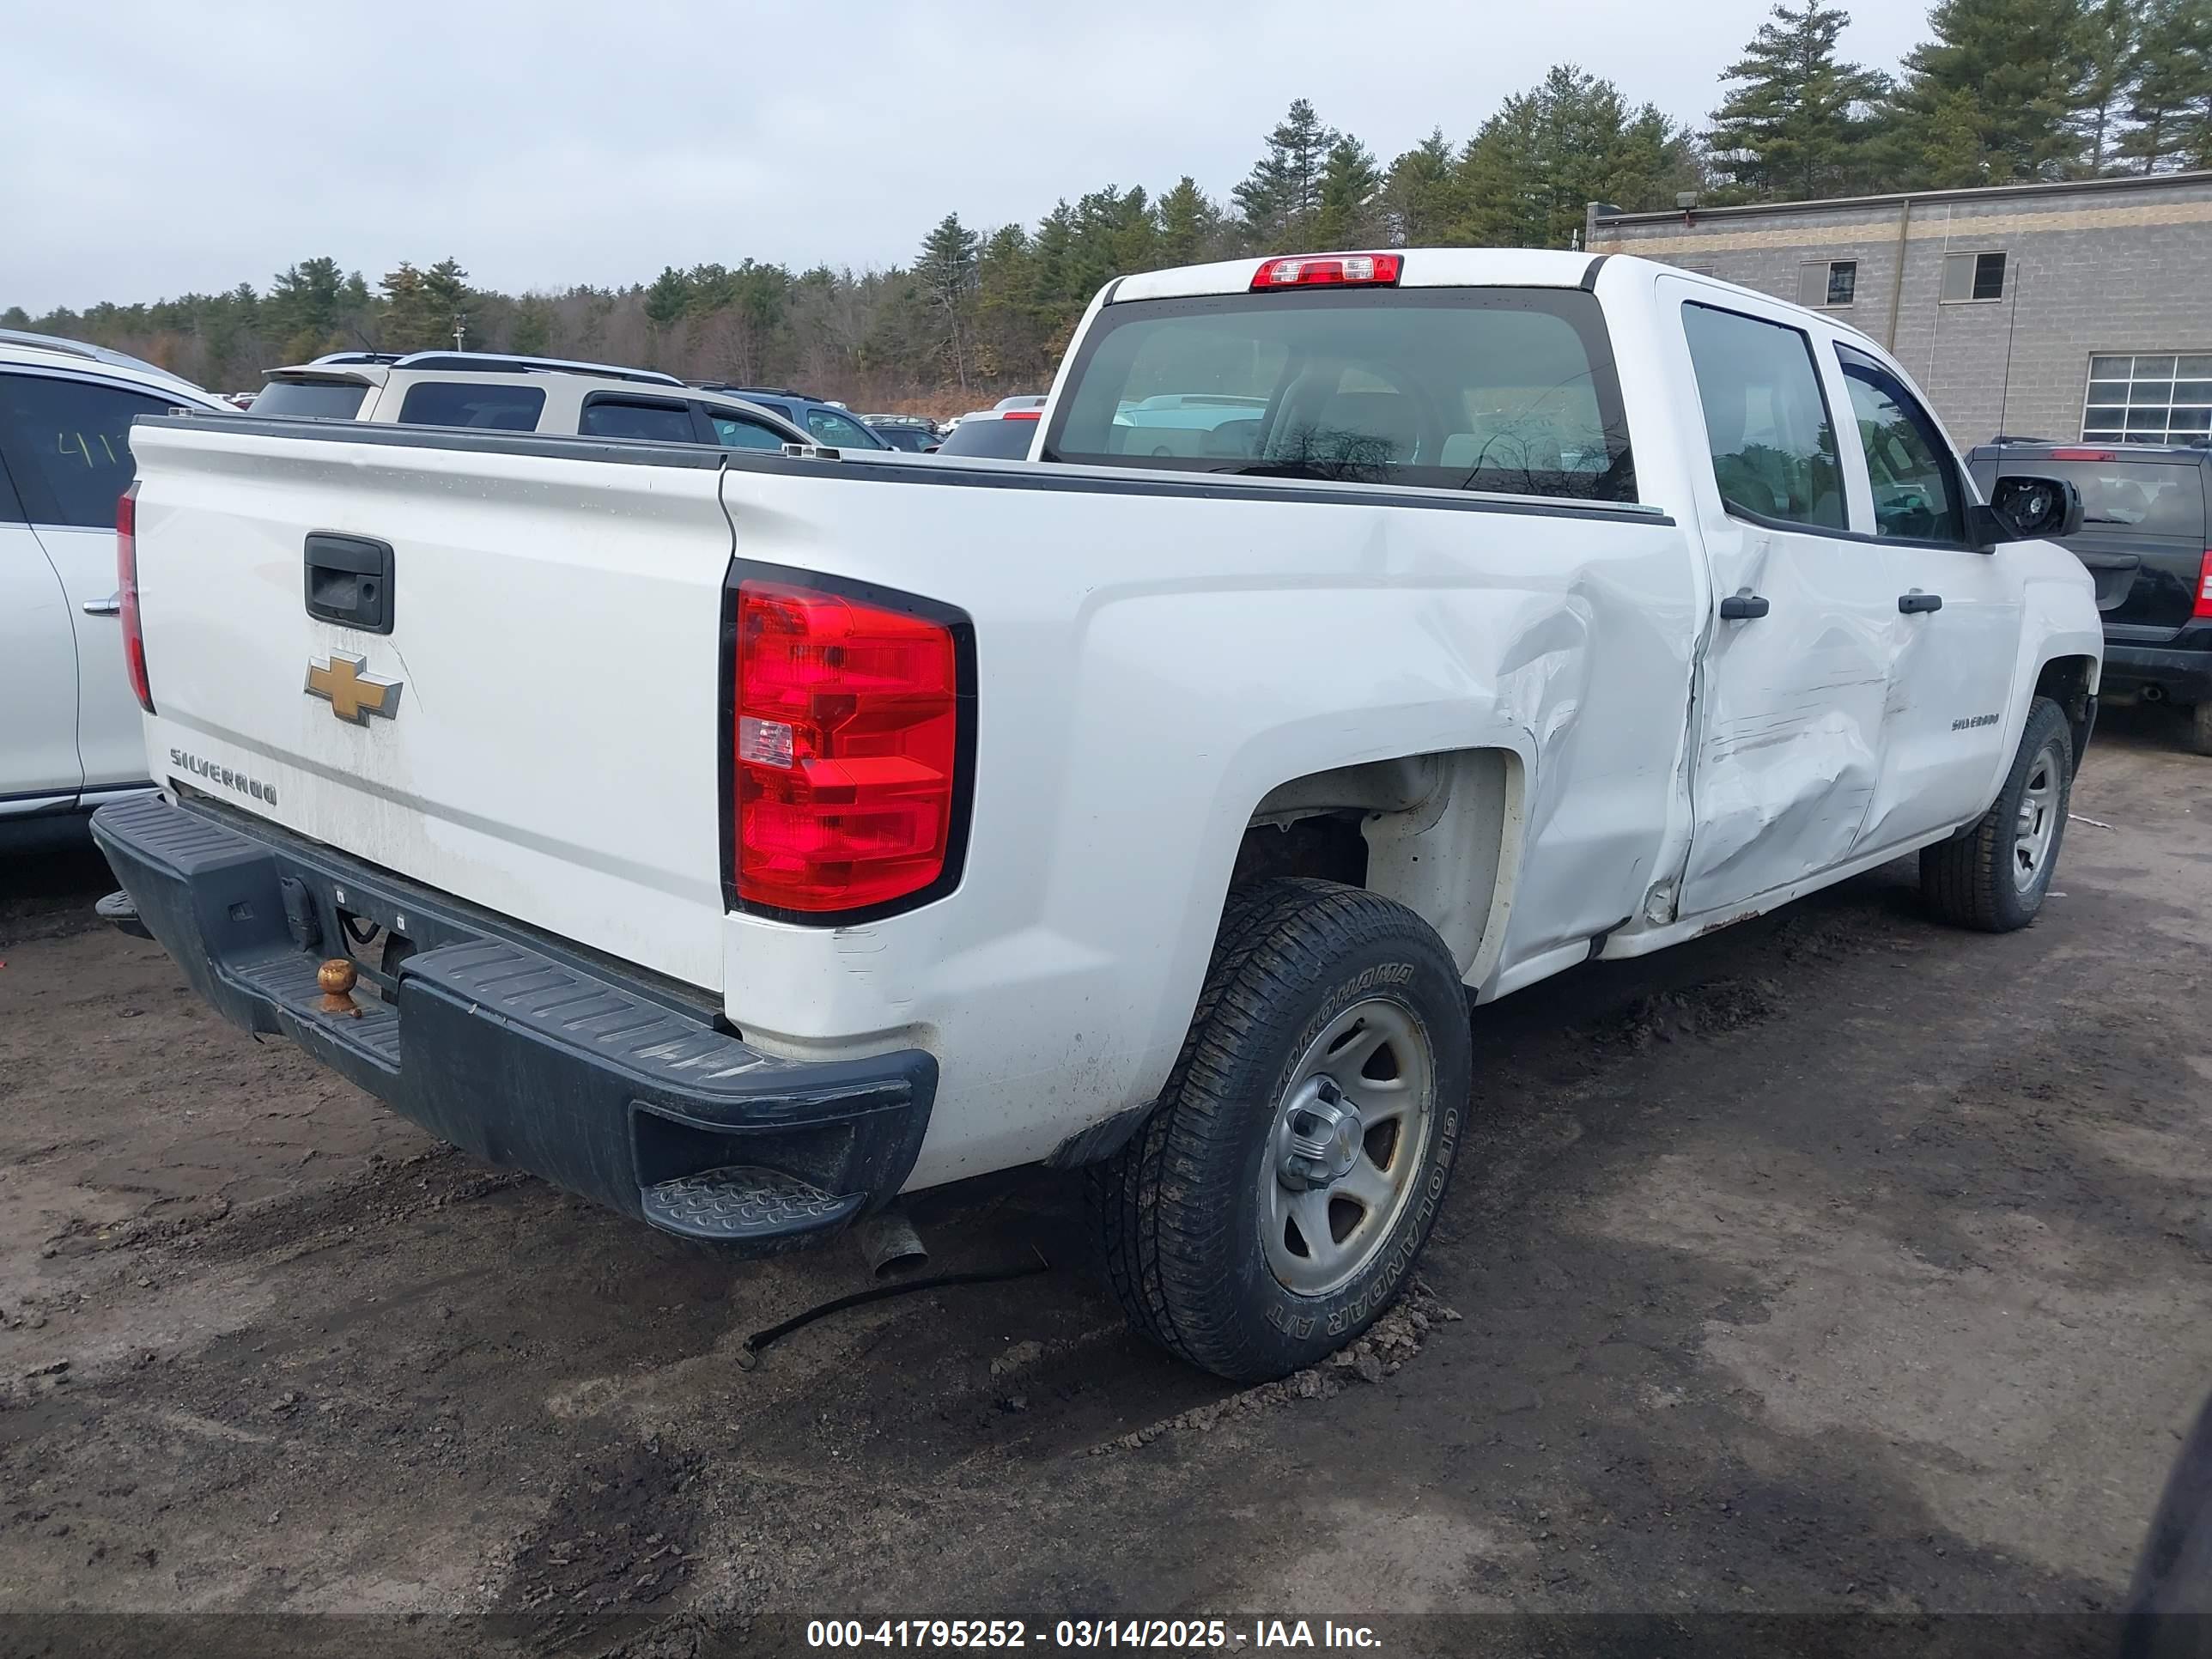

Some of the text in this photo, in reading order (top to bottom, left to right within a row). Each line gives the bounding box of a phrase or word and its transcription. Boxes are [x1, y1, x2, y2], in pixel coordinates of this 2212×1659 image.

[170, 747, 277, 806] SILVERADO
[1267, 963, 1415, 1109] YOKOHAMA
[1265, 1107, 1459, 1340] GEOLANDAR A/T
